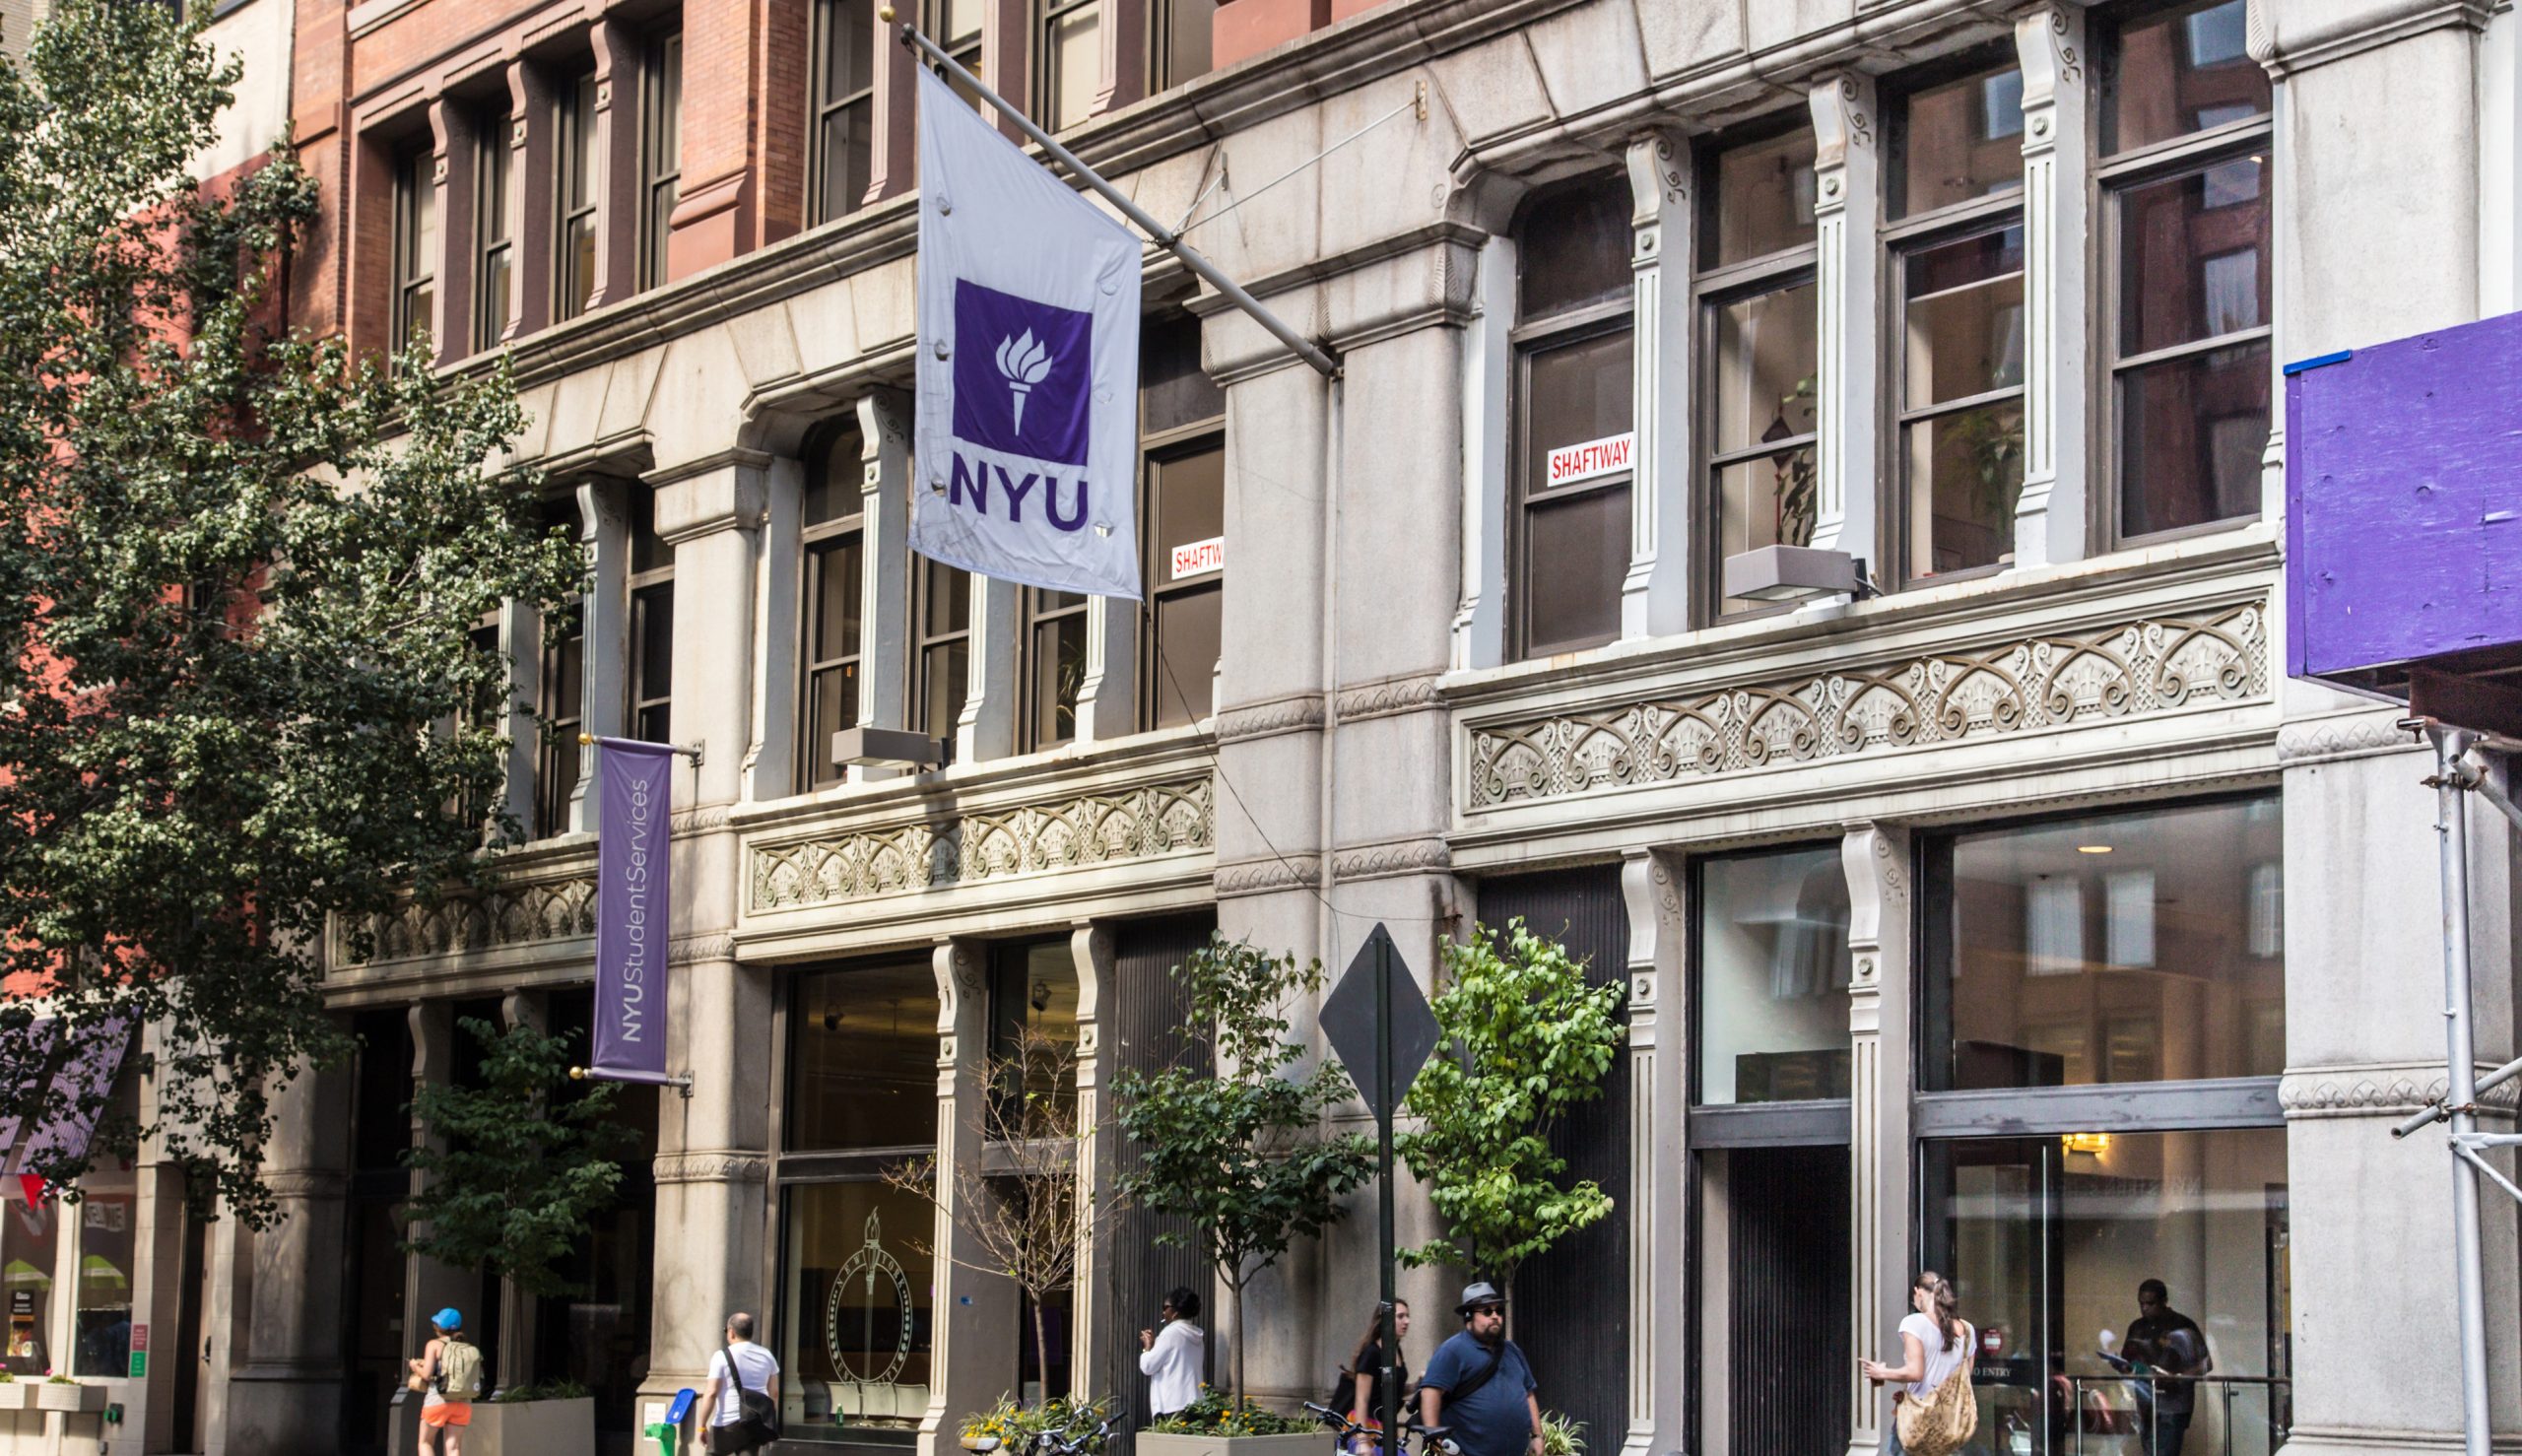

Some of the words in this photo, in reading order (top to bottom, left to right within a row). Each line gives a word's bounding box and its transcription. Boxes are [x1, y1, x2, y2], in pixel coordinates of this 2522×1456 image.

[1553, 439, 1630, 480] SHAFTWAY
[950, 451, 1089, 532] NYU
[836, 1255, 861, 1290] NEW
[881, 1254, 906, 1291] YORK
[1982, 1366, 2012, 1377] ENTRY
